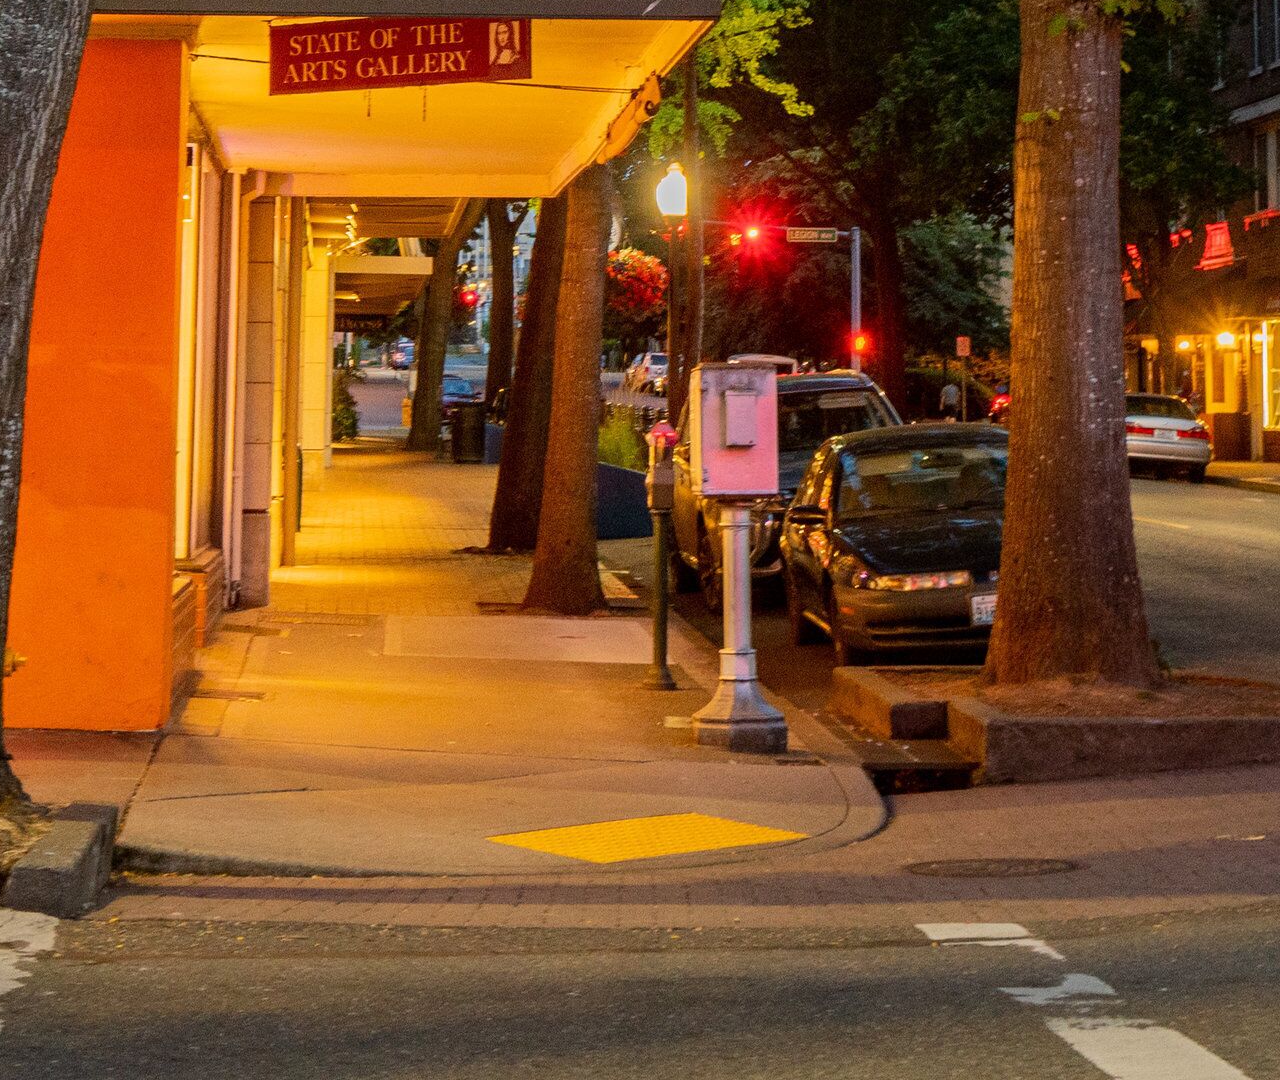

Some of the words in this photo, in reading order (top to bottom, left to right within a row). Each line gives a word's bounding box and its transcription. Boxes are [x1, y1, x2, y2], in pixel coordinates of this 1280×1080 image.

[290, 31, 361, 57] STATE
[370, 28, 401, 49] OF
[411, 23, 465, 46] THE
[284, 60, 347, 84] ARTS
[357, 50, 472, 78] GALLERY
